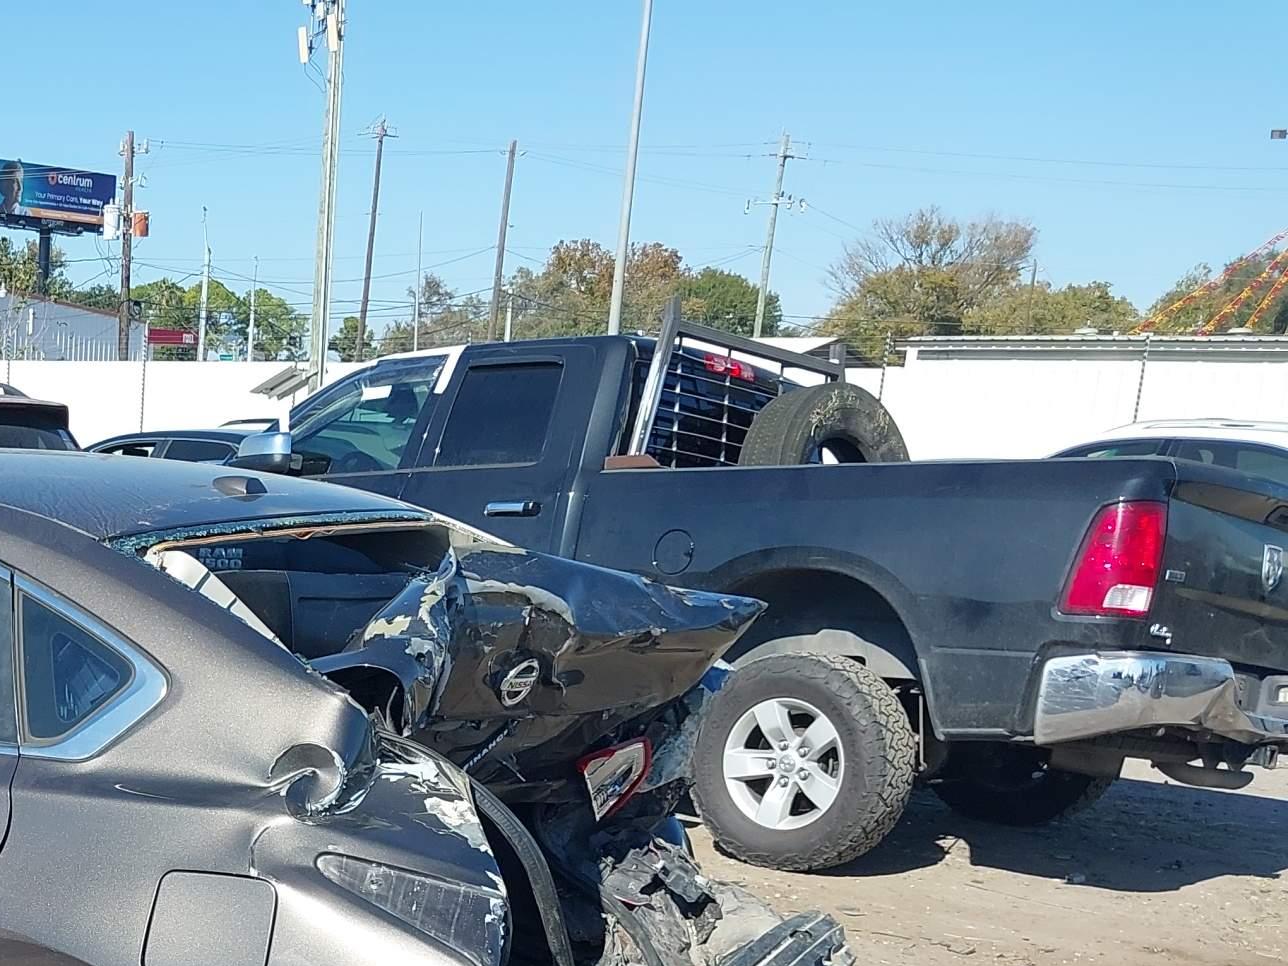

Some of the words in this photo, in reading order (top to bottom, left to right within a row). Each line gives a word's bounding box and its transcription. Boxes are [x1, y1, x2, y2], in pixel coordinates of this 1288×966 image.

[58, 174, 93, 188] centrum
[47, 192, 65, 202] Primary
[199, 547, 243, 559] RAM
